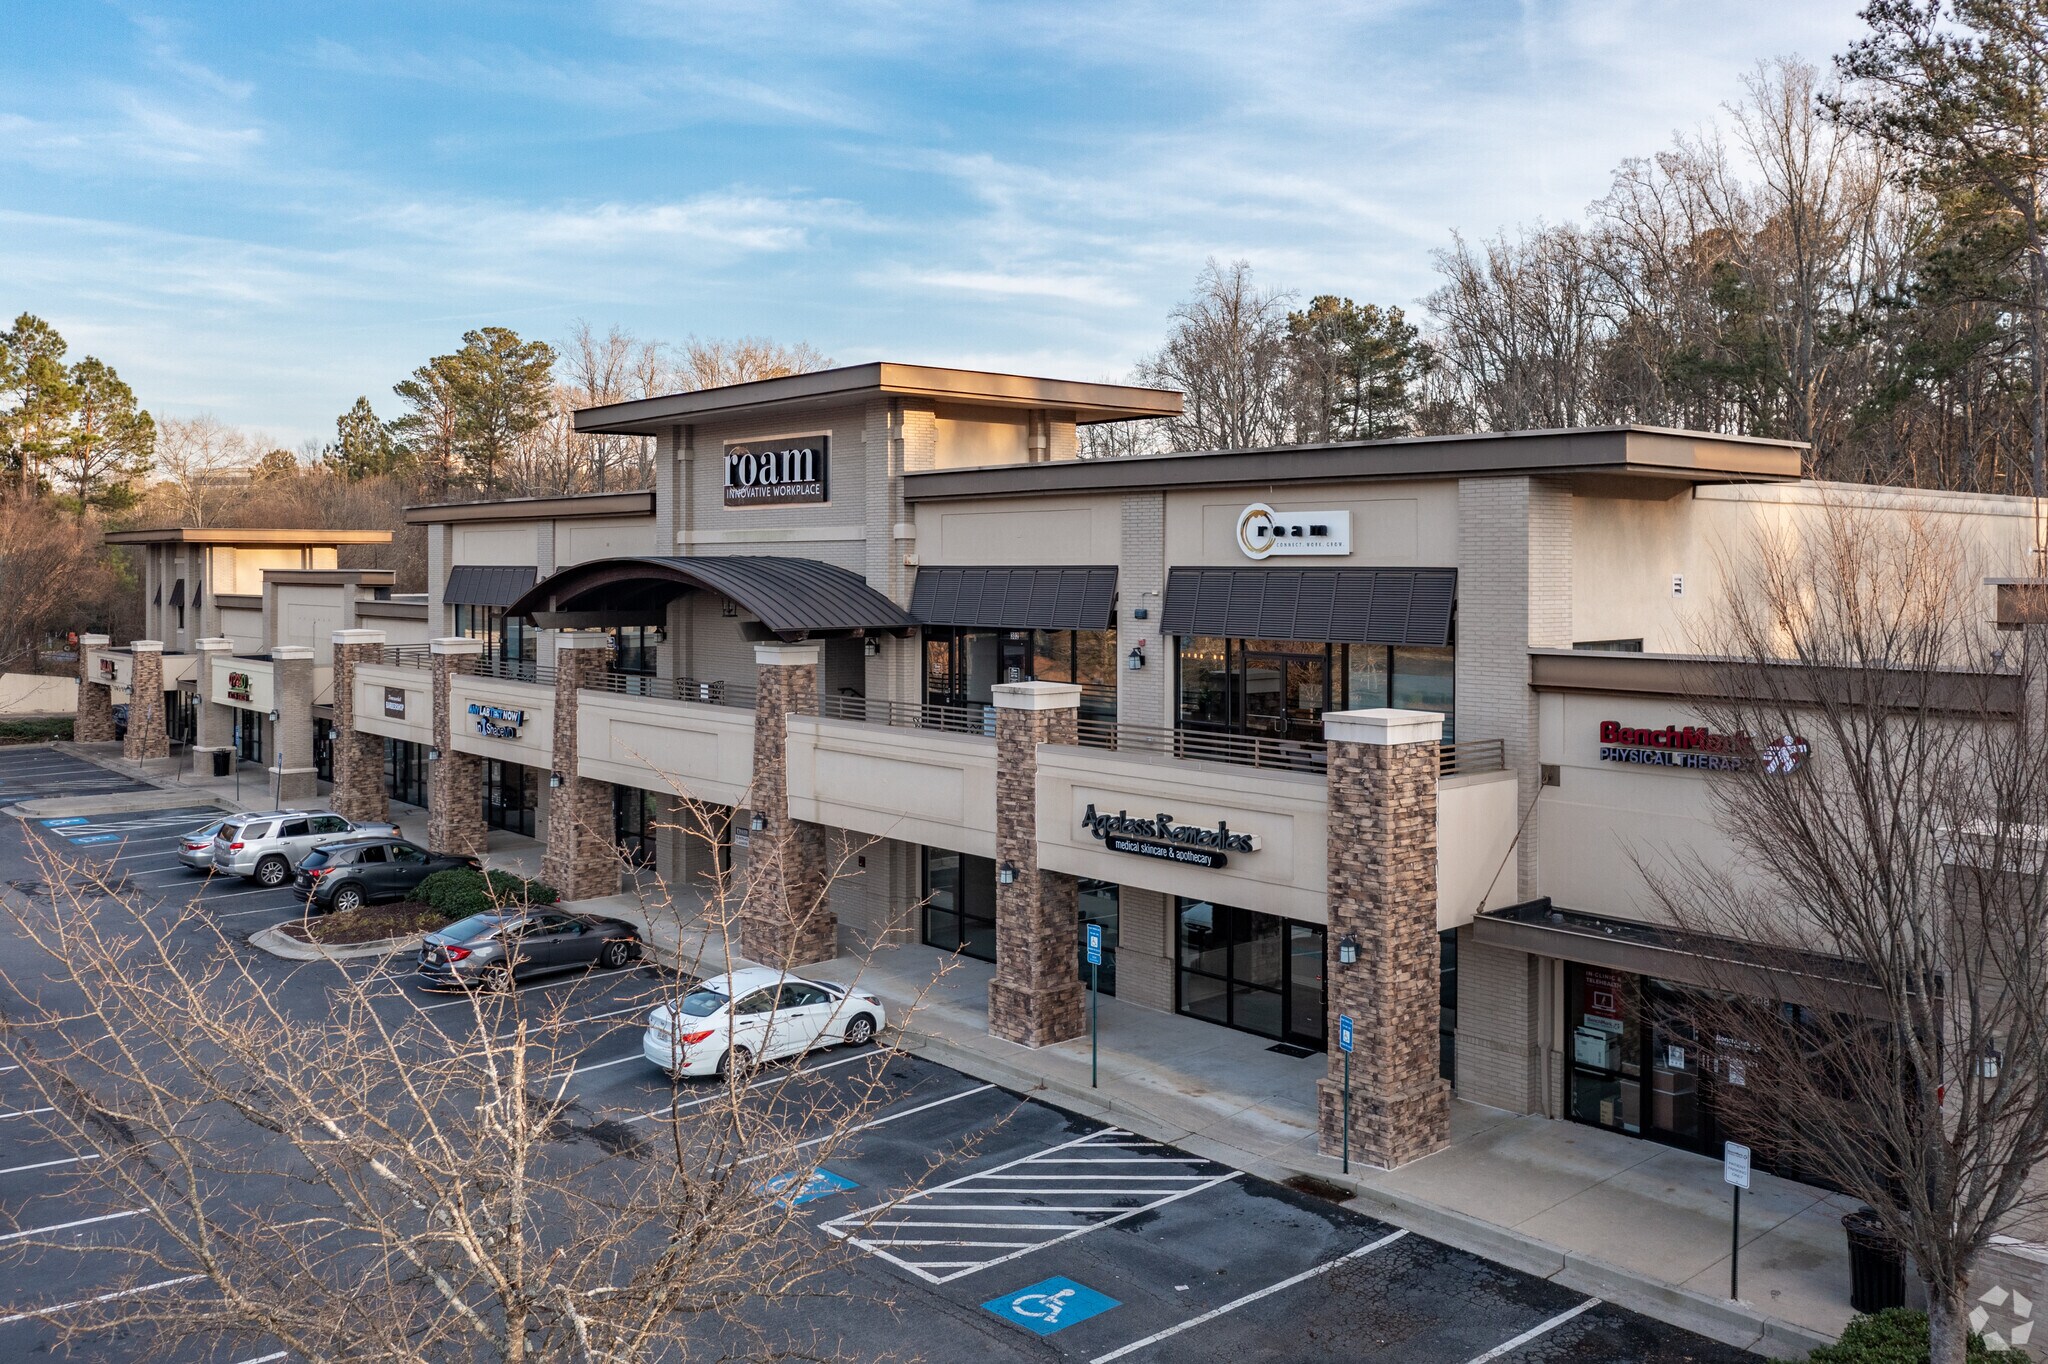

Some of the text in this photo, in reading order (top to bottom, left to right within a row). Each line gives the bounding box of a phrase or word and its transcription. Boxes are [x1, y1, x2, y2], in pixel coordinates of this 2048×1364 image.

[723, 448, 815, 487] roam
[726, 484, 820, 499] INNOVATIVE WORKPLACE
[1257, 525, 1328, 537] roam
[479, 705, 490, 717] LAB
[1600, 747, 1674, 767] PHYSICAL
[1082, 804, 1254, 853] Ageless Remedies
[1115, 840, 1212, 867] medical skincare & apothecary
